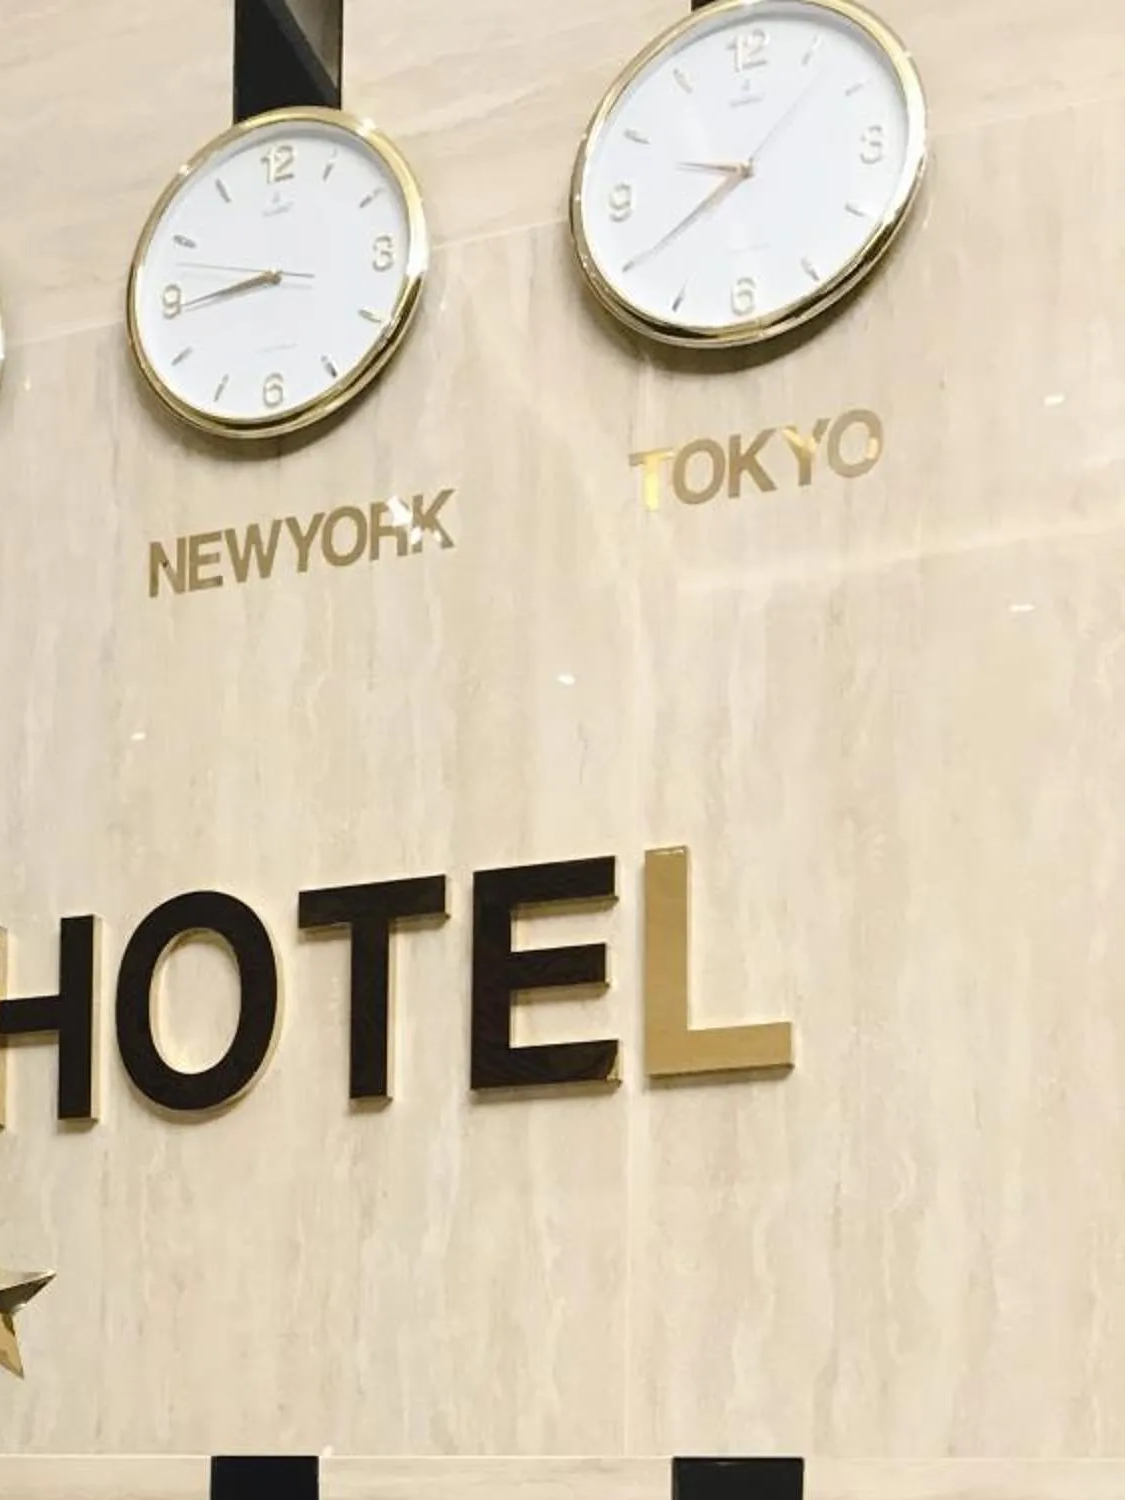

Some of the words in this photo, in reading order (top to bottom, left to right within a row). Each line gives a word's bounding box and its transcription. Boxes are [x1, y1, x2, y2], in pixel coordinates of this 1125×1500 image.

[726, 27, 770, 73] 12
[261, 144, 295, 184] 12
[860, 124, 884, 165] 3
[609, 183, 633, 223] 9
[373, 235, 394, 272] 3
[162, 283, 182, 320] 9
[731, 276, 756, 316] 6
[262, 372, 284, 409] 6
[628, 408, 885, 512] TOKYO
[148, 488, 457, 598] NEWYORK
